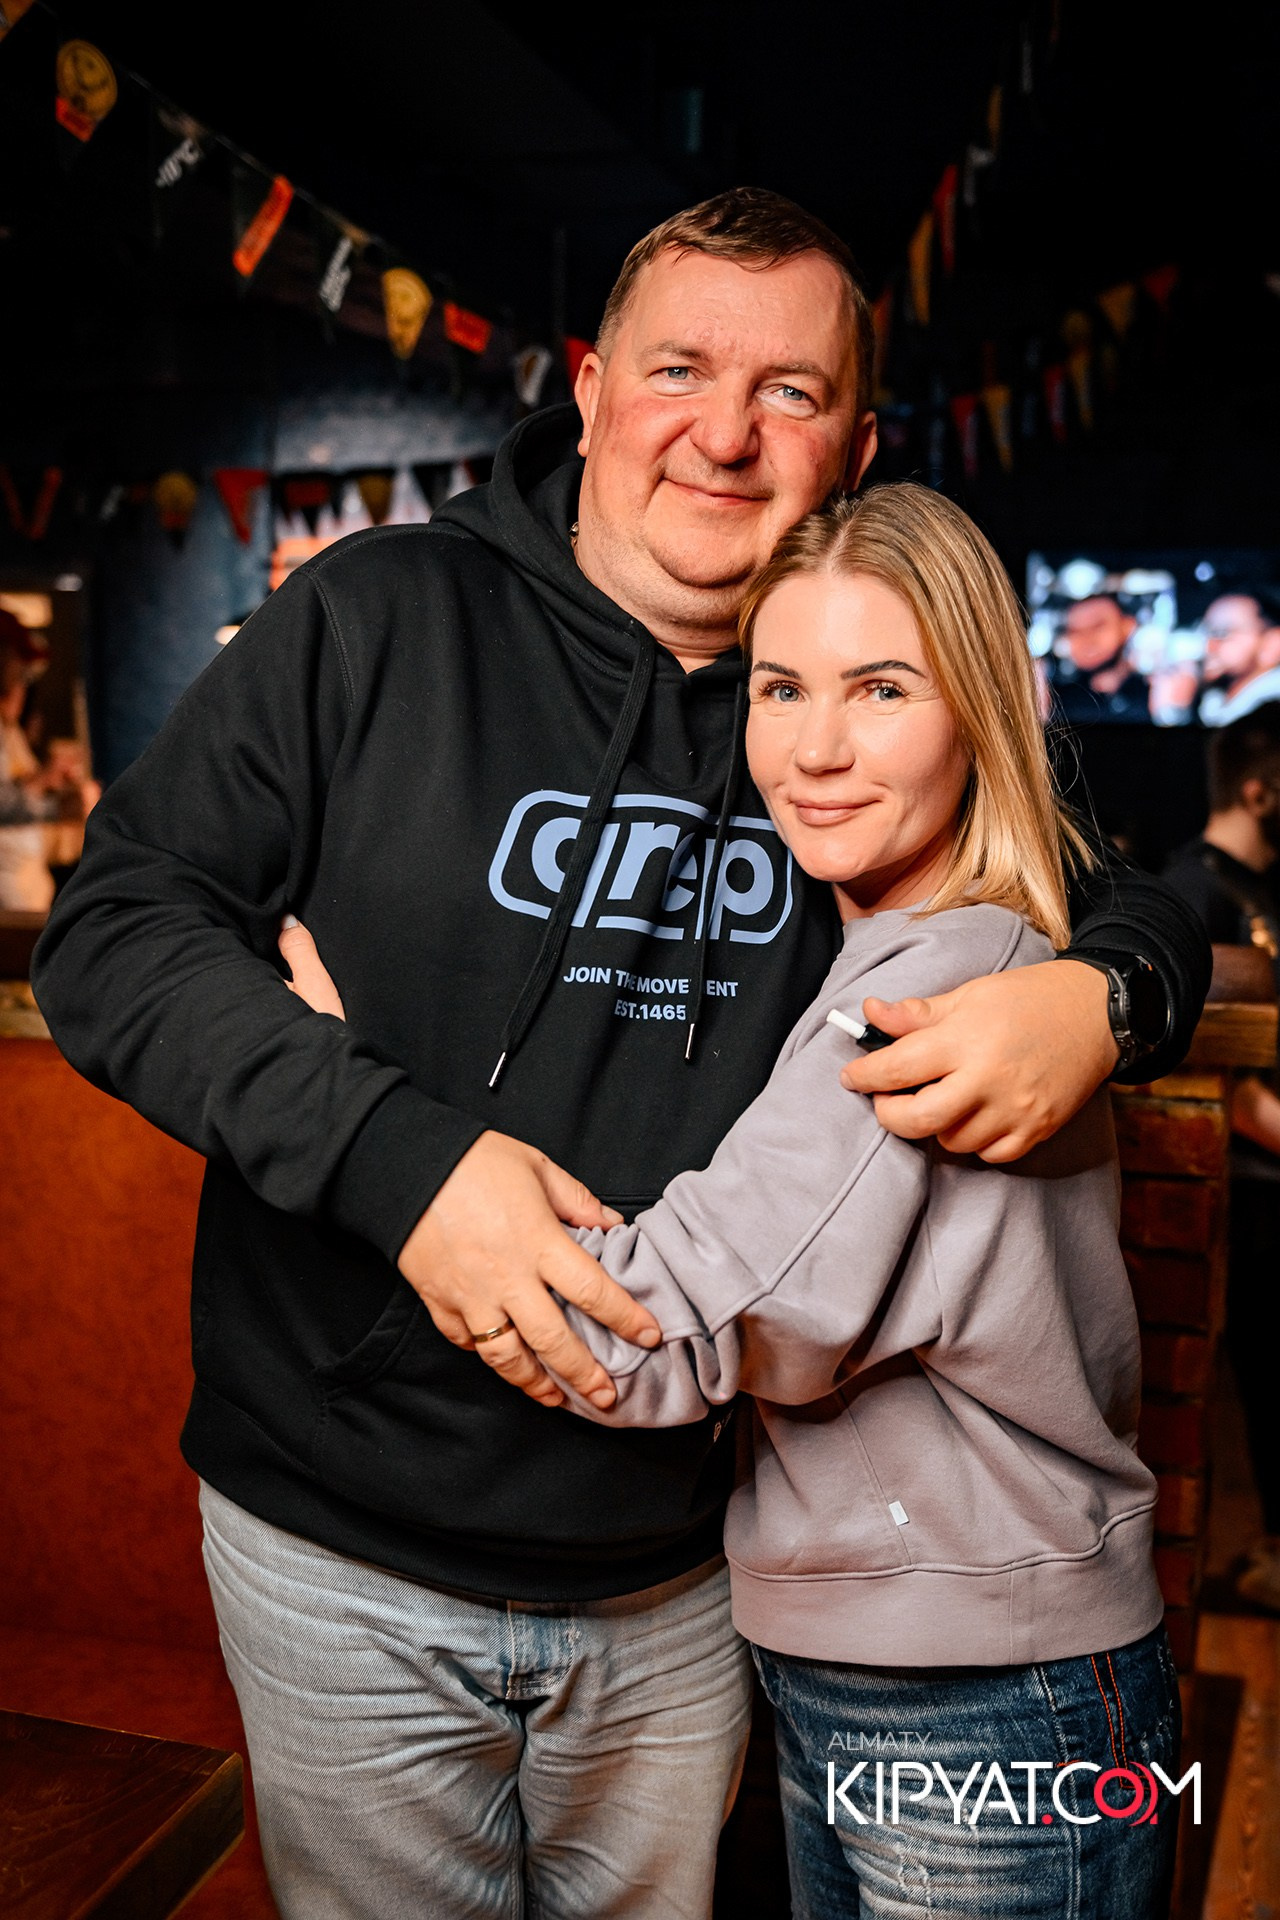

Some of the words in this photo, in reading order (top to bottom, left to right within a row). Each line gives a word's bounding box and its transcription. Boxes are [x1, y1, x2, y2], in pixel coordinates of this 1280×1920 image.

[563, 967, 611, 984] JOIN
[615, 969, 637, 991] THE
[636, 977, 739, 997] MOVEENT
[614, 999, 687, 1021] EST.1465
